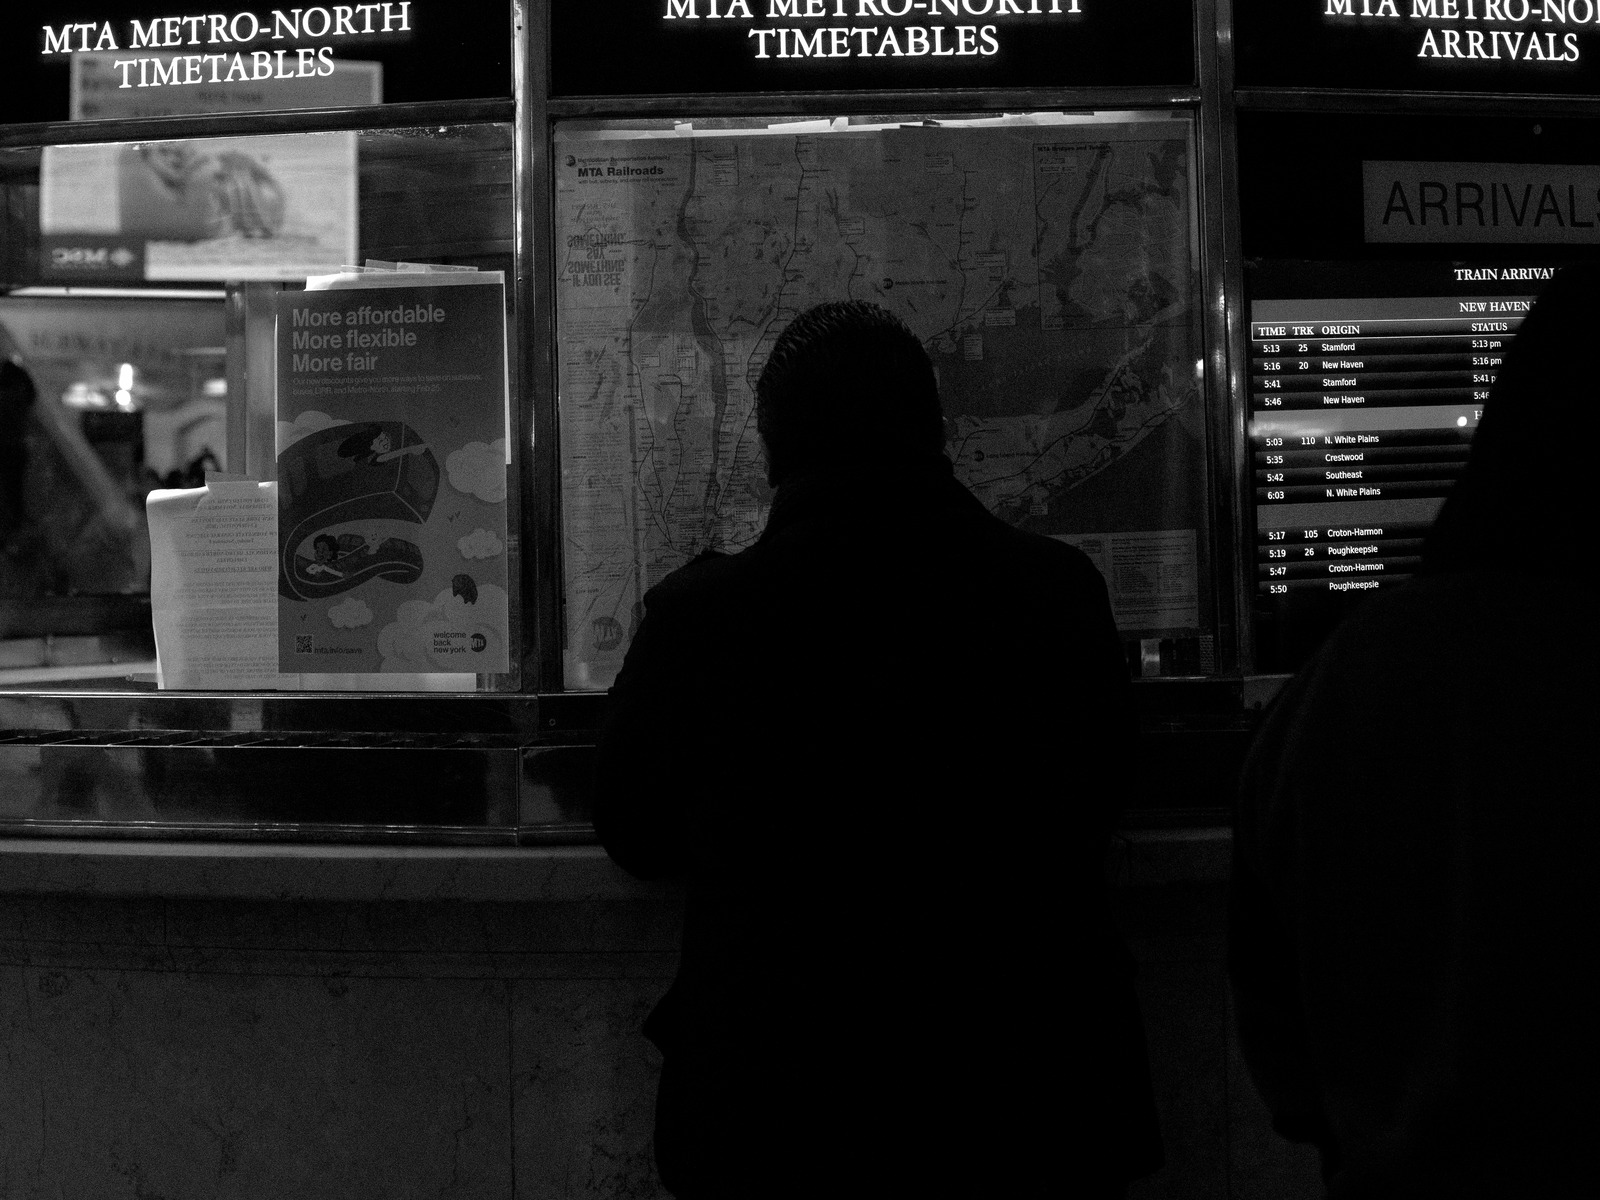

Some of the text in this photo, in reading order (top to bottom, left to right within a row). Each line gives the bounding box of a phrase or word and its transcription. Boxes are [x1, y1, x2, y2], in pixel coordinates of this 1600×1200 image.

[42, 1, 412, 55] MTA METRO-NORTH
[749, 25, 998, 58] TIMETABLES
[1418, 29, 1579, 61] ARRIVALS
[114, 46, 336, 89] TIMETABLES
[578, 166, 664, 178] MTA Railroads
[1382, 181, 1600, 227] ARRIVAL
[1455, 269, 1497, 280] TRAIN
[1460, 302, 1529, 312] NEW HAVEN
[293, 303, 446, 327] More affordable
[1258, 323, 1507, 335] TIME TRK ORIGIN STATUS
[293, 328, 417, 349] More flexible
[1263, 340, 1502, 353] 5:13 25 Stamford 5:13 pm
[293, 351, 378, 372] More fair
[1263, 357, 1502, 371] 5:16 20 New Haven 5:16 pm
[1264, 374, 1497, 389] 5:41 Stamford 5:41 p
[1264, 397, 1282, 406] 5:46
[1323, 395, 1340, 405] New
[1341, 395, 1365, 405] Haven
[1265, 434, 1380, 447] 5:03 110 N. White Plains
[1266, 452, 1364, 464] 5:35 Crestwood
[1267, 470, 1363, 482] 5:42 Southeast
[1267, 486, 1381, 500] 6:03 N. White Plains
[1268, 527, 1383, 540] 5:17 105 Croton-Harmon
[1269, 545, 1379, 558] 5:19 26 Poughkeepsie
[1269, 563, 1384, 576] 5:47 Croton-Harmon
[1270, 580, 1380, 594] 5:50 Poughkeepsie
[450, 646, 466, 654] york
